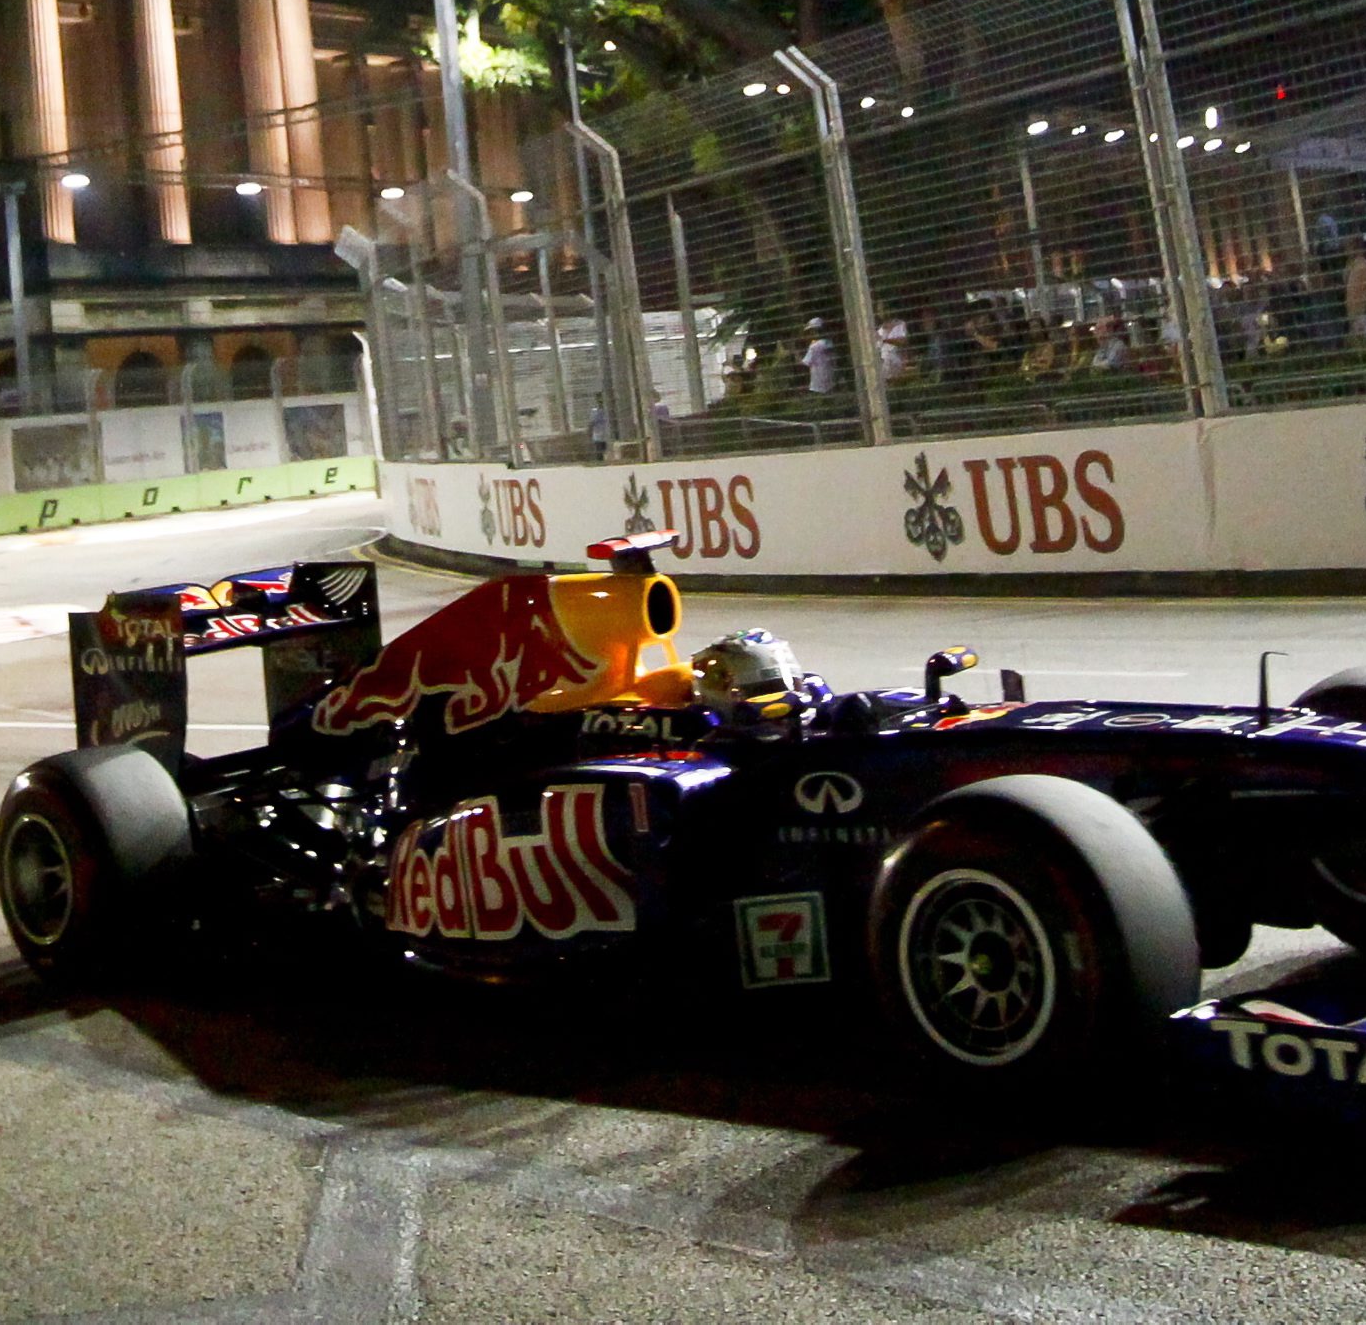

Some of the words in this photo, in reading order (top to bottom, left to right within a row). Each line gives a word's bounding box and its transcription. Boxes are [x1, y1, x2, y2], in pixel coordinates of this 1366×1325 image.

[492, 478, 546, 548] UBS
[657, 475, 760, 559] UBS
[962, 450, 1125, 555] UBS
